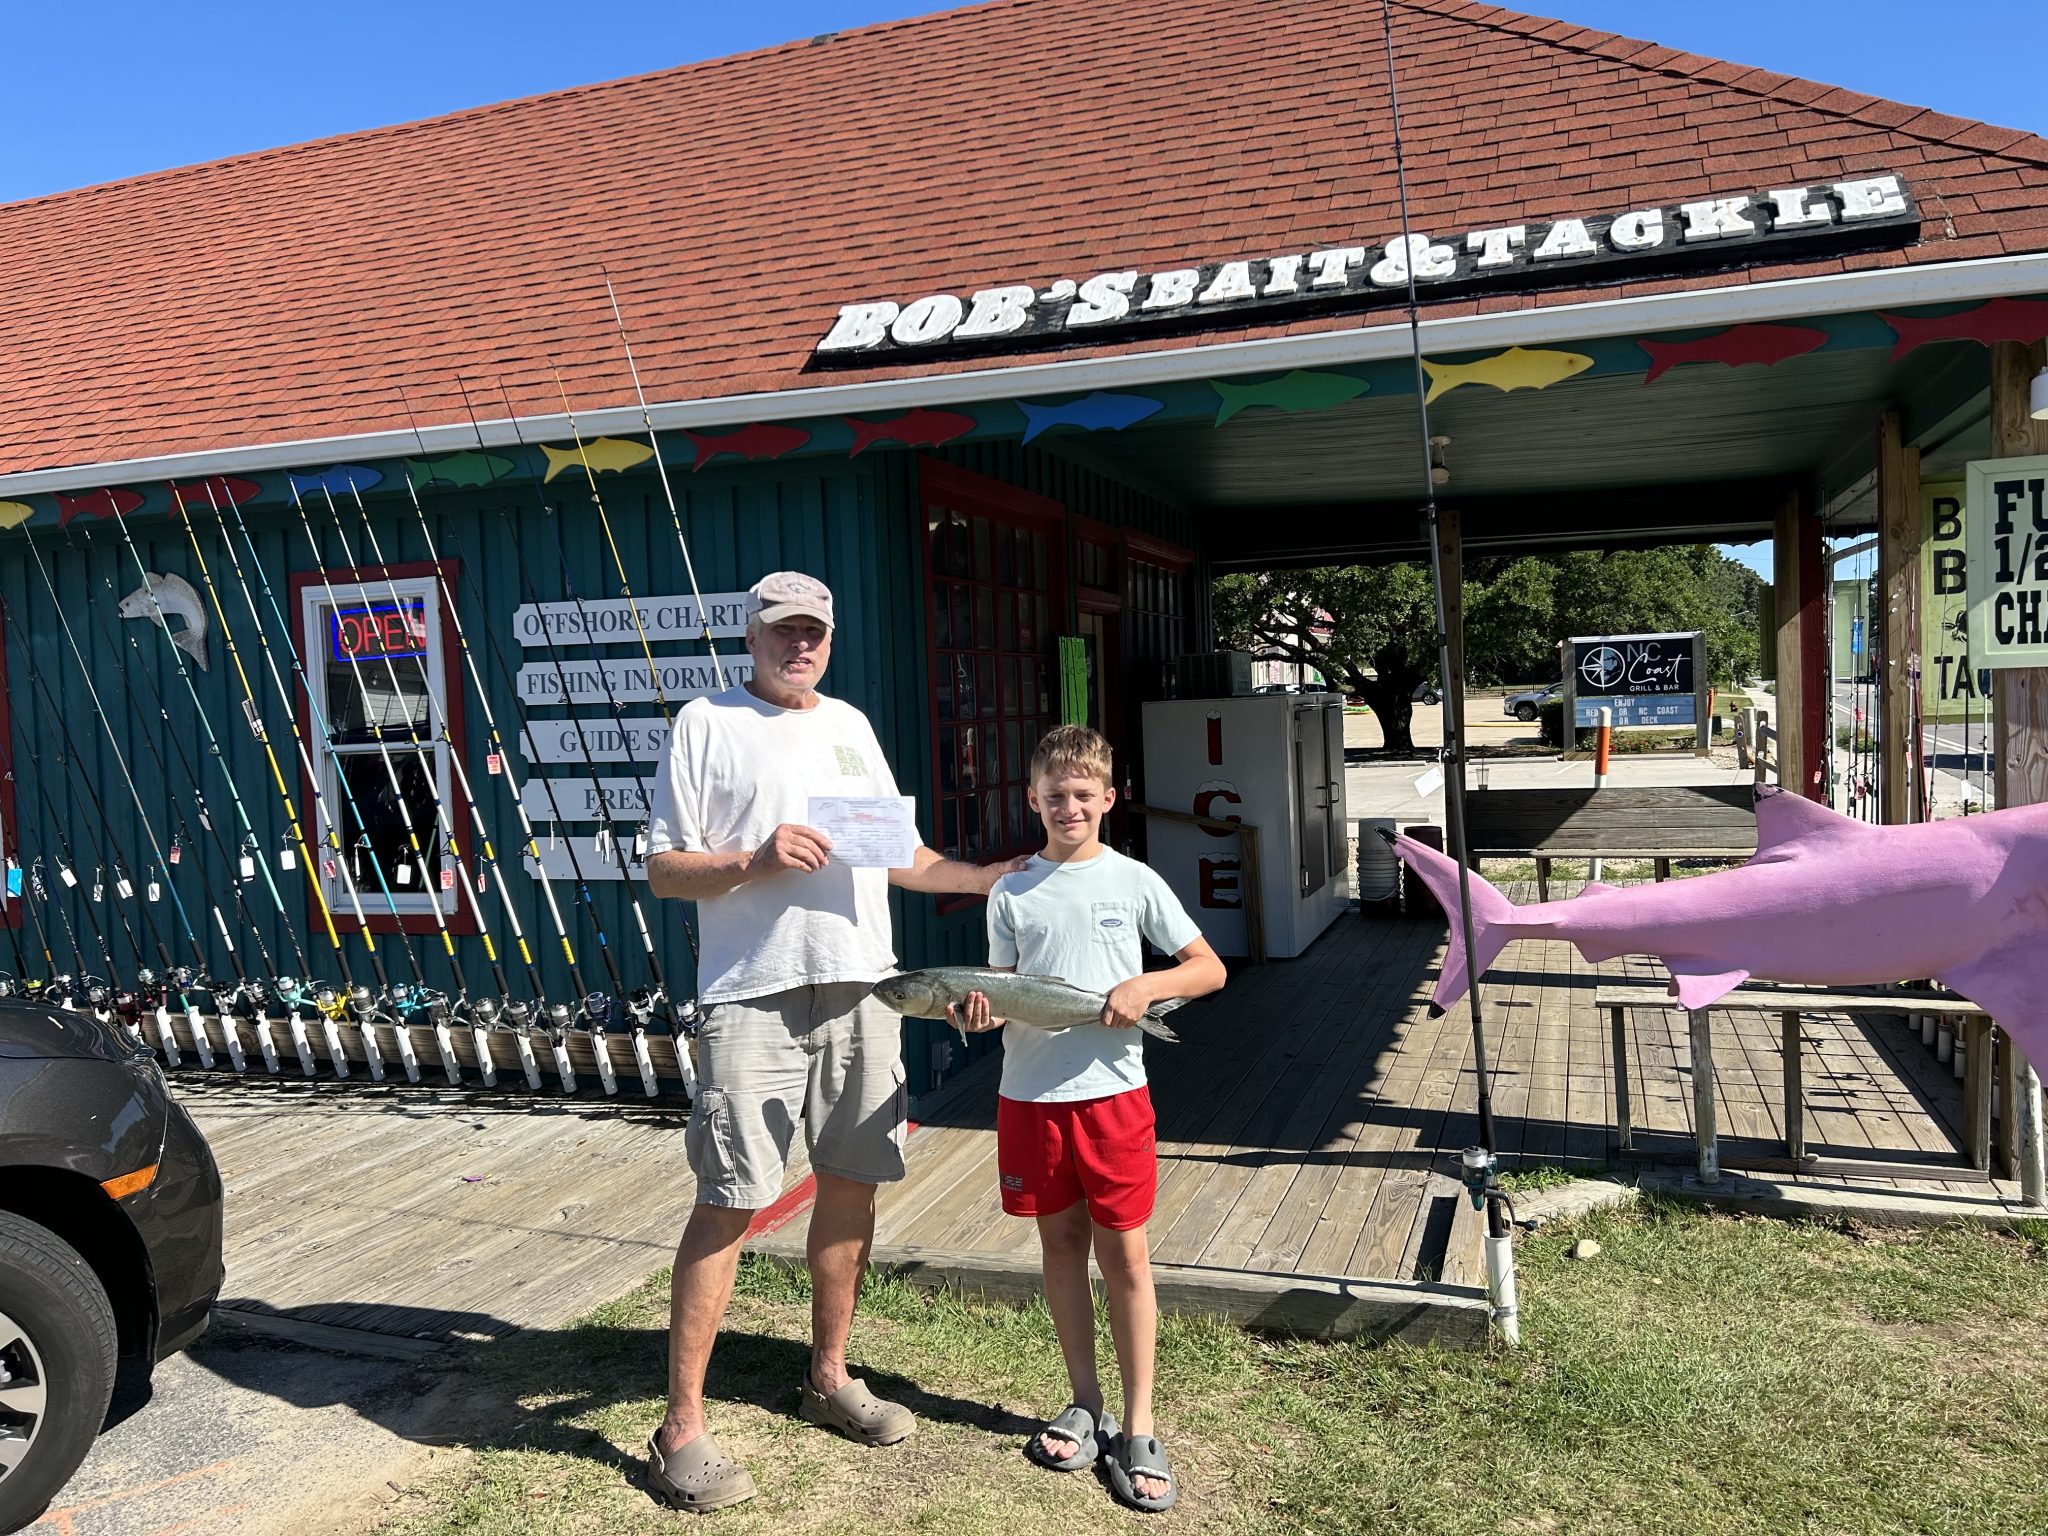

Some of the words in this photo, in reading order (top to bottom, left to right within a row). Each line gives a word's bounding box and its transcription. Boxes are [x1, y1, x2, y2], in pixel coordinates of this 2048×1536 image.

[817, 269, 1138, 353] BOB'S
[1142, 247, 1365, 311] BAIT
[1370, 232, 1456, 288] &
[1467, 174, 1907, 269] TACKLE
[523, 607, 650, 637] OFFSHORE
[1994, 589, 2048, 645] CH
[338, 612, 427, 655] OPEN
[1627, 643, 1661, 662] NC
[527, 669, 617, 695] FISHING
[1628, 653, 1691, 683] Coast
[1614, 698, 1636, 707] ENJOY
[1638, 706, 1649, 715] NC
[1656, 706, 1680, 715] COAST
[1619, 716, 1629, 725] OR
[1641, 716, 1659, 725] DECK
[559, 729, 641, 752] GUIDE
[1193, 709, 1242, 909] ICE
